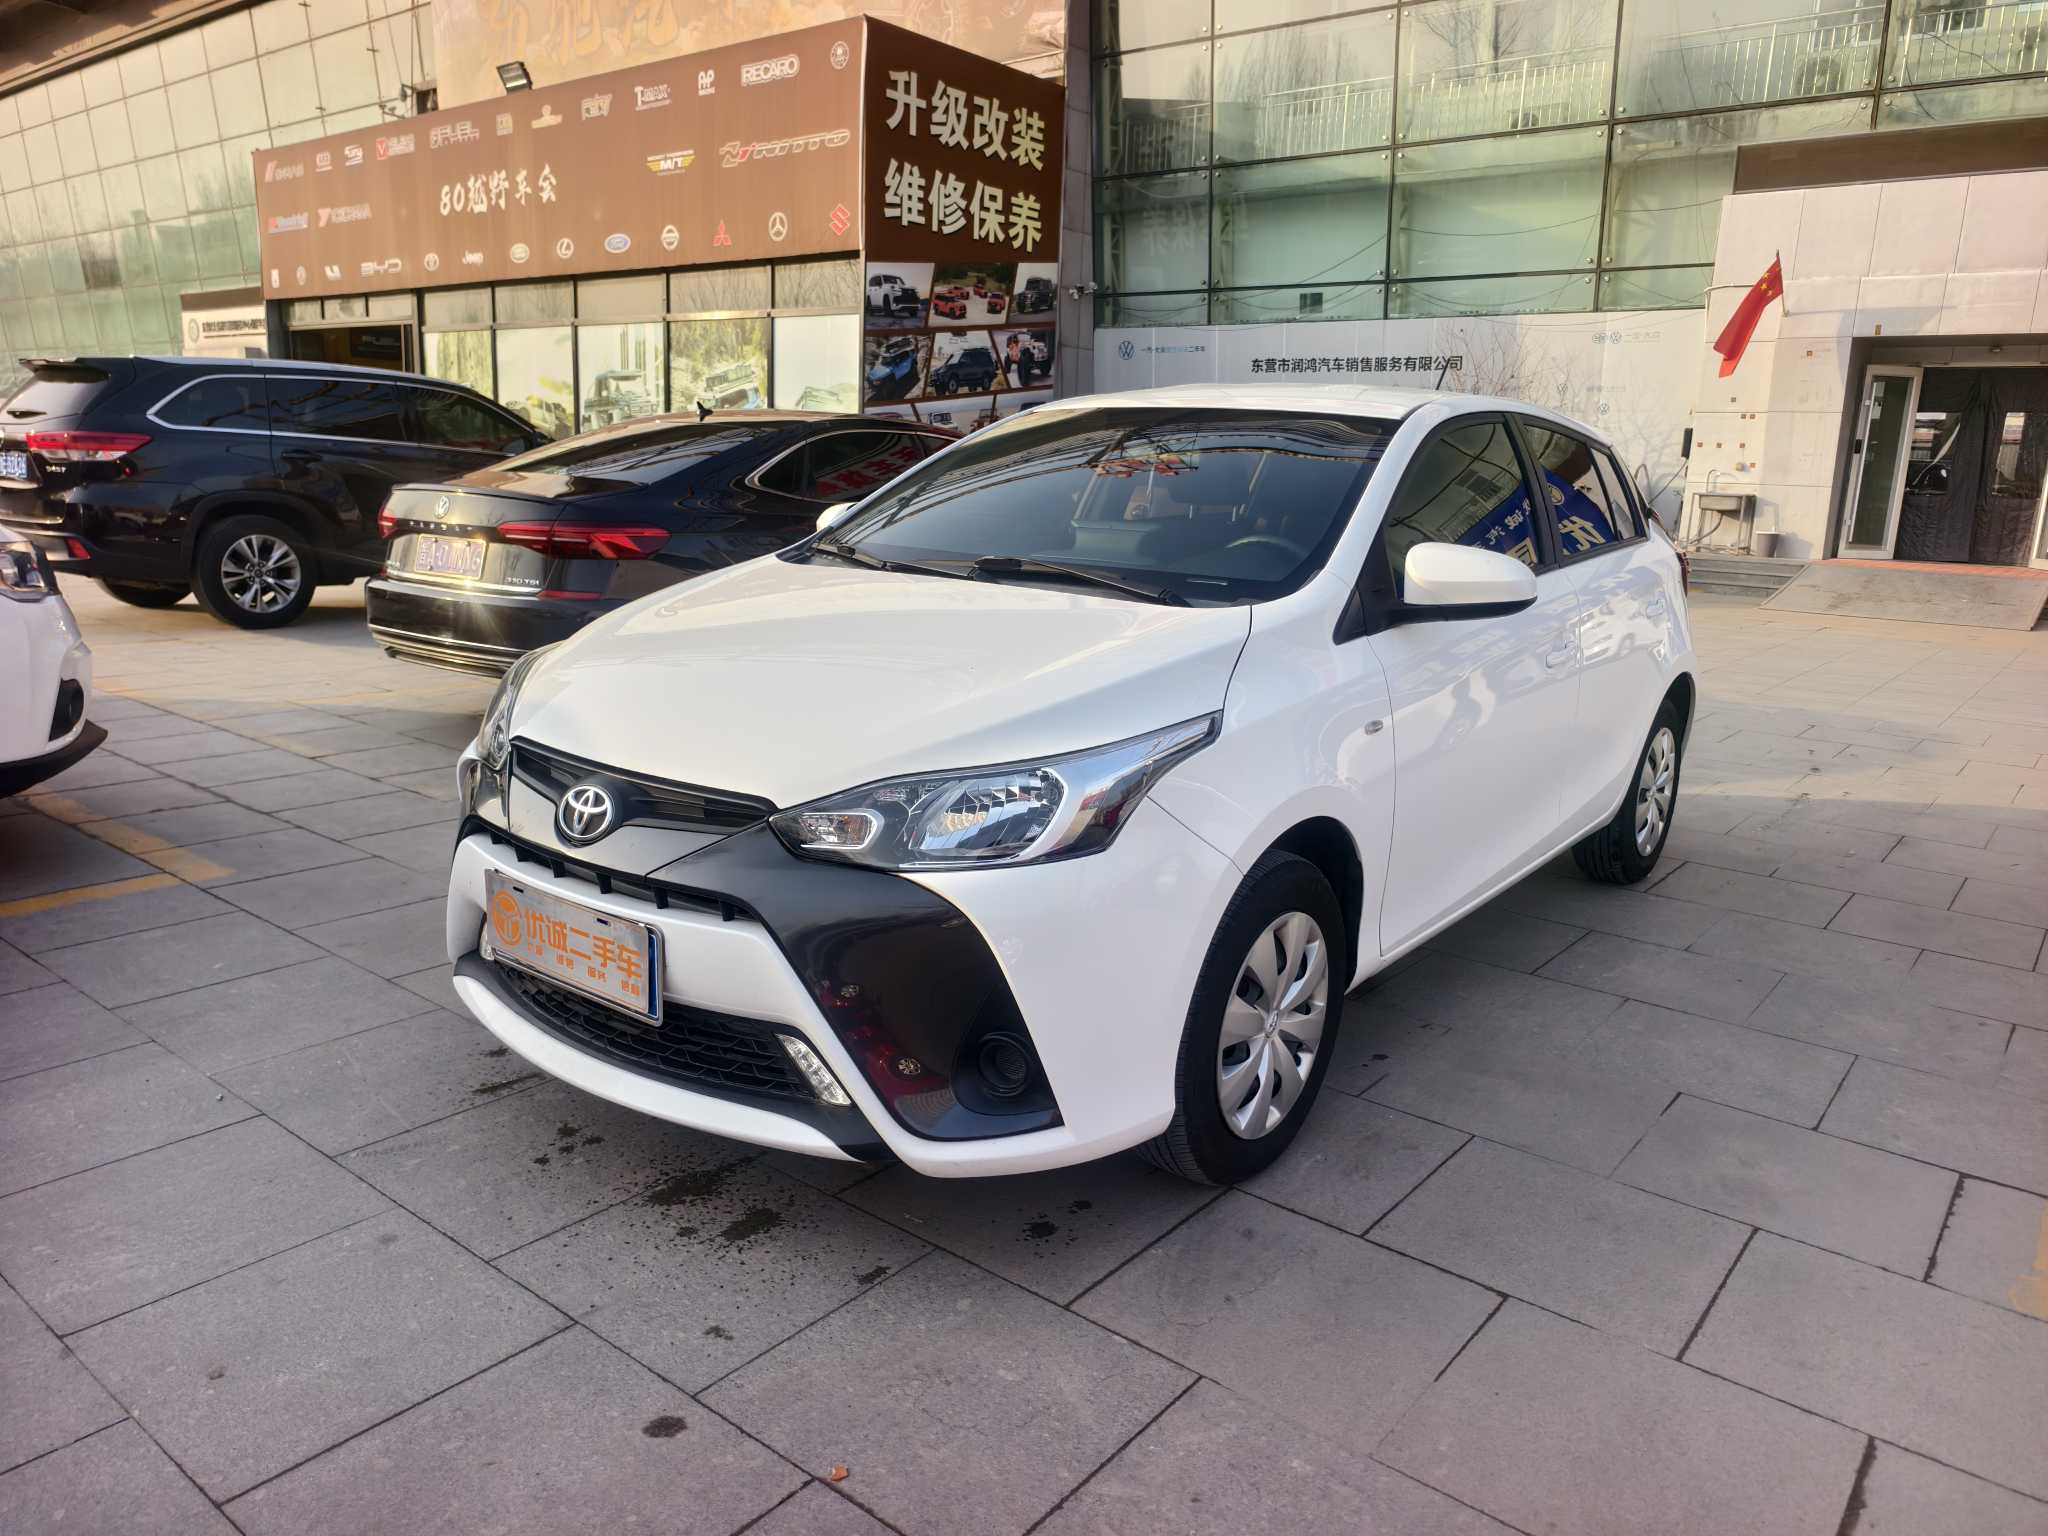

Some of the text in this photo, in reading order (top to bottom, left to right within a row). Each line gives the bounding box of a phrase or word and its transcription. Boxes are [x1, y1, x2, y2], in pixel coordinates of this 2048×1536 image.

[743, 56, 798, 84] RECARO
[884, 70, 1046, 171] 升级改装
[883, 158, 1042, 252] 维修保养
[361, 258, 402, 277] BYD
[1250, 354, 1463, 373] 东营市润鸿汽车销售服务有限公司
[523, 908, 642, 980] 优诚二手车
